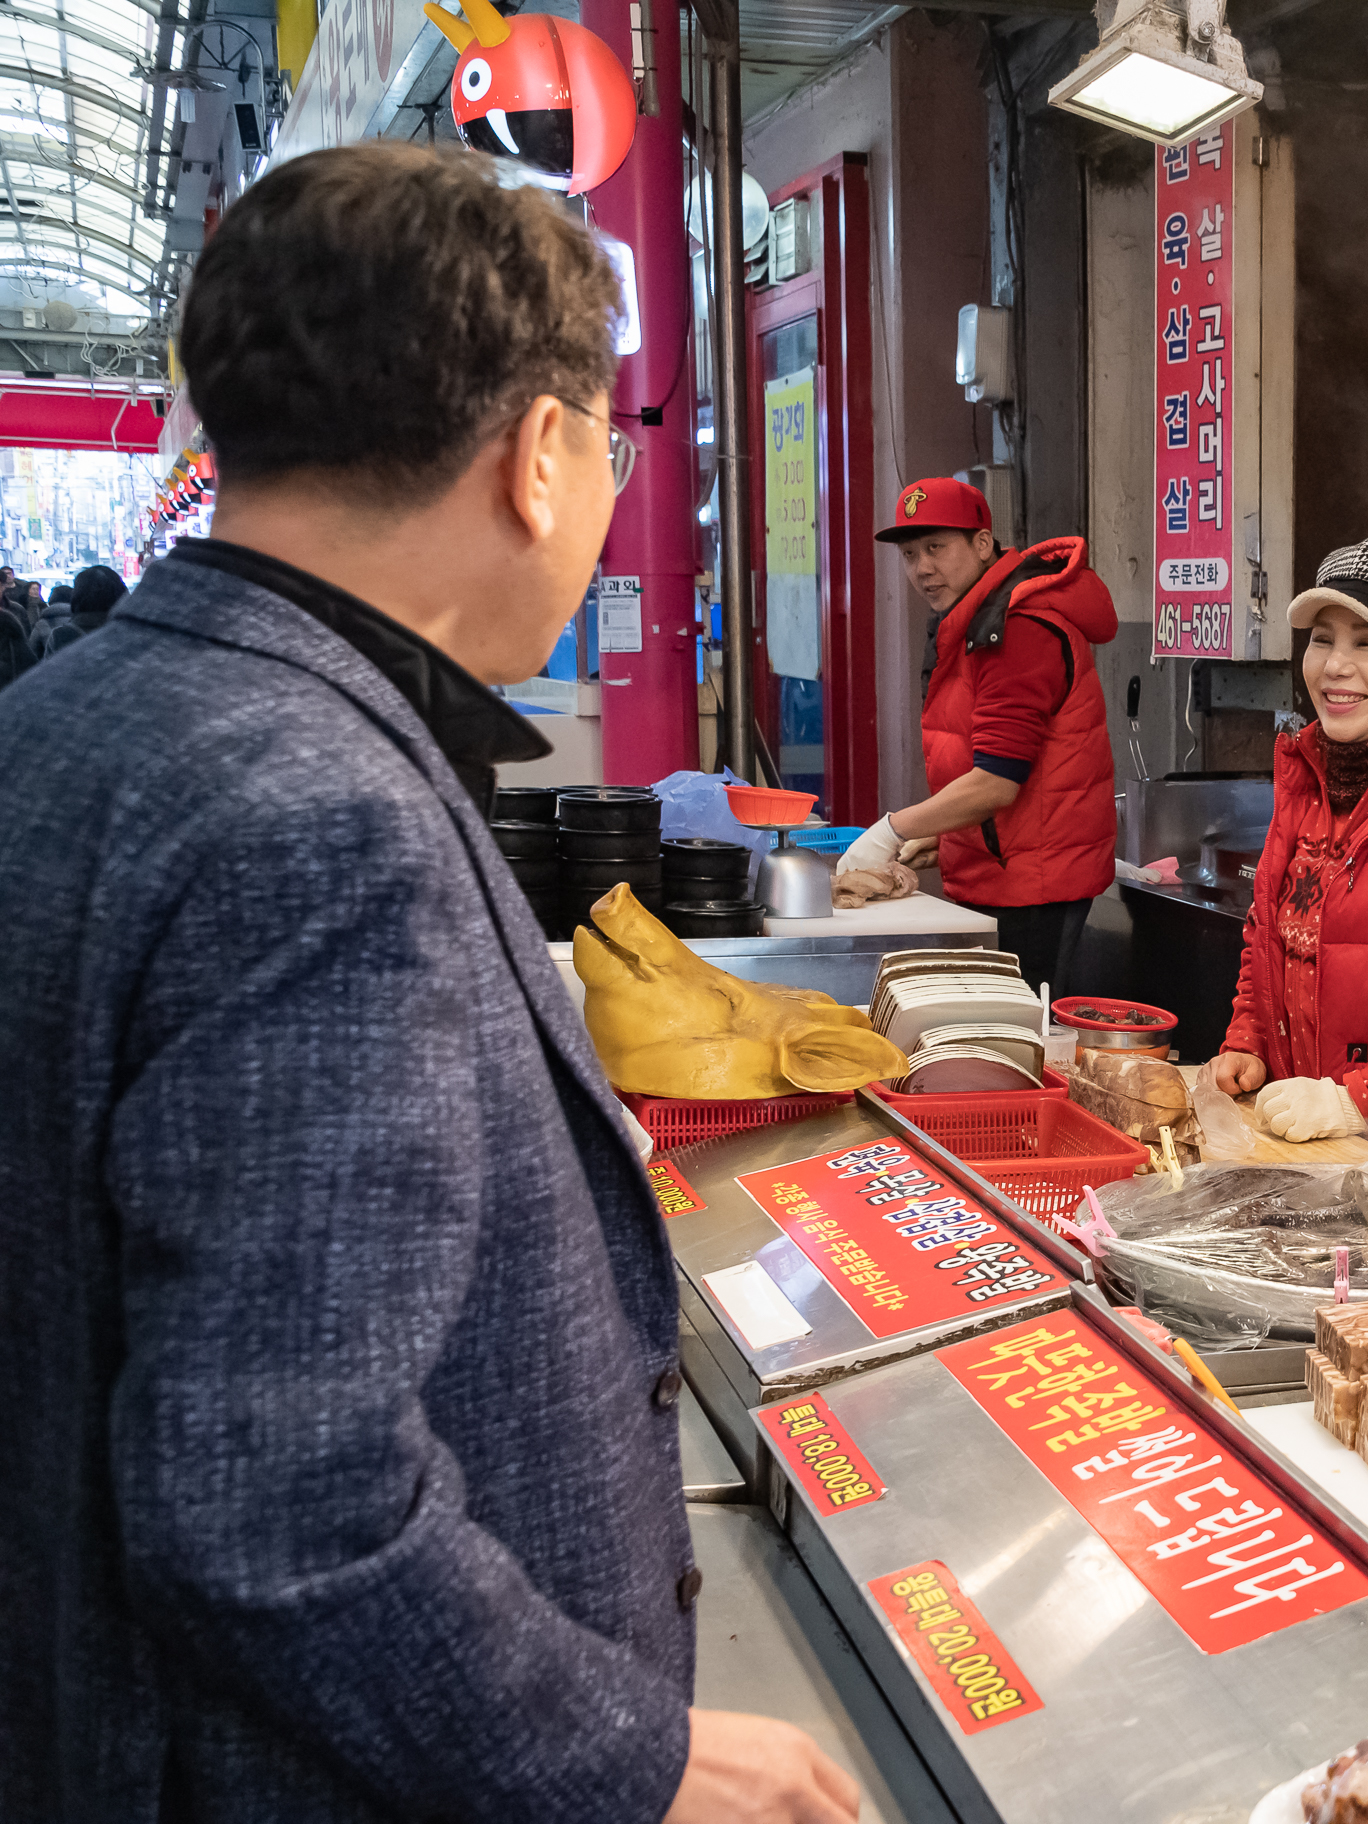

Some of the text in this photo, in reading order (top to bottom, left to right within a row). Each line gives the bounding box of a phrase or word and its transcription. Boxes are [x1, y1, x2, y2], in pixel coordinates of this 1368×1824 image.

[1168, 562, 1219, 586] 주문전화
[1157, 602, 1232, 650] 461-5687
[786, 1200, 829, 1224] 행사
[803, 1219, 845, 1244] 음식
[780, 1403, 874, 1506] 특대 18,000원
[968, 1328, 1344, 1619] 따뜻한 족발 썰어 드립니다
[892, 1570, 1022, 1720] 왕특대 20,000원
